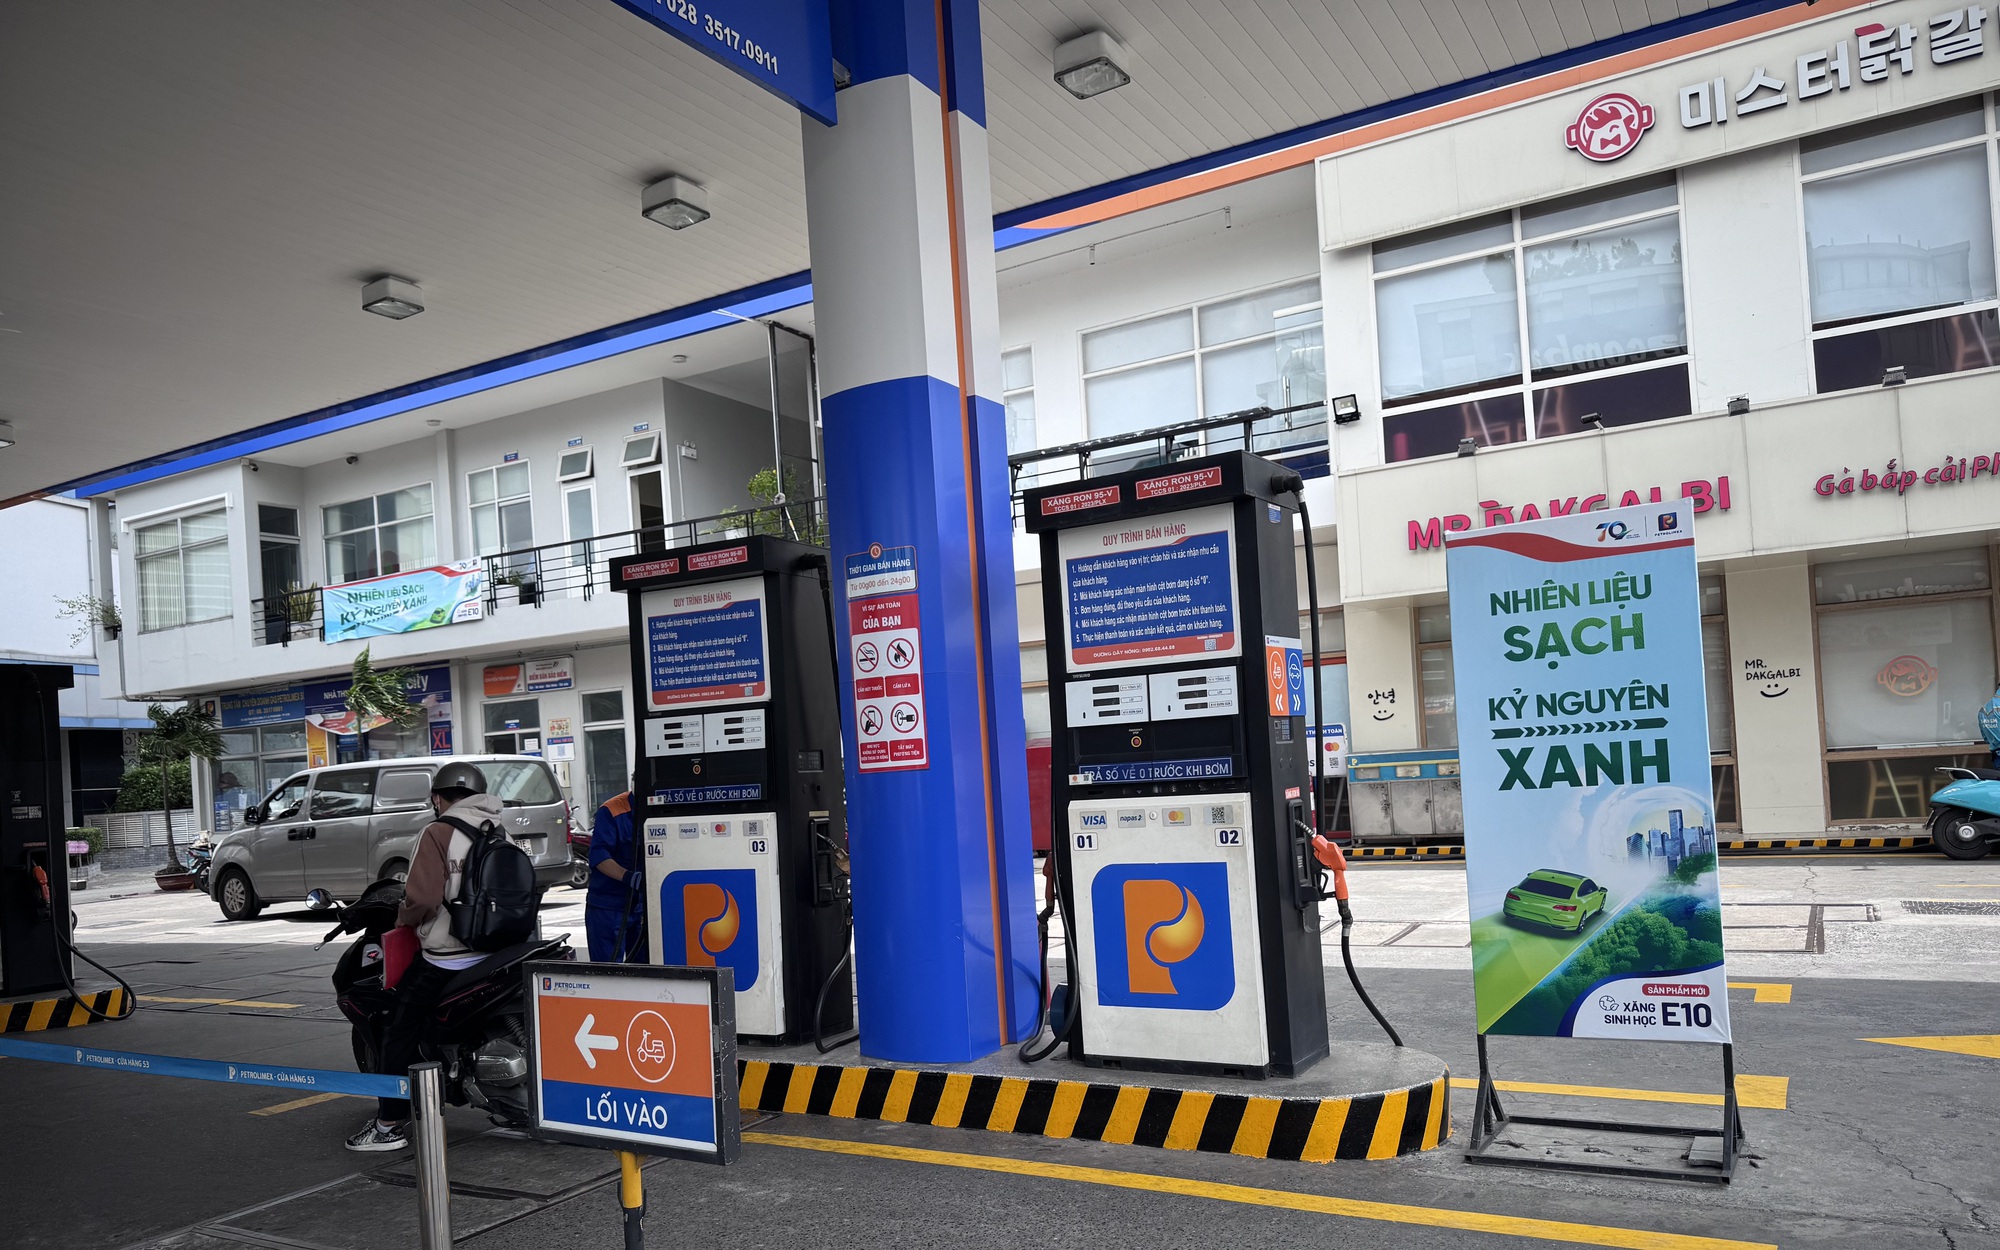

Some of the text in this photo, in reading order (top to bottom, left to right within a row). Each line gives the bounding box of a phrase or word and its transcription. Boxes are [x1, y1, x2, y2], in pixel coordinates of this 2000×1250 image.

[704, 14, 778, 74] 3517.0911
[1679, 4, 2000, 128] 미스터닭갈
[1171, 477, 1191, 486] RON
[1194, 471, 1213, 482] 95-V
[1816, 467, 1854, 496] Gà
[1861, 459, 1917, 494] bắp
[1924, 455, 1966, 484] cải
[1074, 494, 1092, 502] RON
[1094, 490, 1112, 498] 95-V
[1103, 523, 1186, 546] QUY TRÌNH BÁN HÀNG
[1103, 560, 1116, 569] khách
[1117, 559, 1128, 568] hàng
[1200, 546, 1209, 556] nhu
[849, 558, 910, 574] THỜI GIAN BÁN HÀNG
[859, 581, 875, 590] 00g00
[877, 578, 889, 588] đến
[891, 576, 910, 586] 24g00
[348, 589, 385, 603] NHIÊN
[674, 591, 732, 608] QUY TRÌNH BÁN HÀNG
[1489, 570, 1651, 616] NHIÊN LIỆU
[402, 596, 428, 612] XANH
[863, 615, 901, 629] CỦA BẠN
[1504, 612, 1645, 670] SẠCH
[1745, 658, 1767, 669] MR.
[1746, 668, 1801, 681] DAKGALBI
[1368, 688, 1395, 705] 안녕
[1488, 678, 1669, 721] KỶ NGUYÊN
[432, 732, 451, 749] XL
[1106, 766, 1119, 780] SỐ
[1122, 765, 1136, 779] VỀ
[1140, 768, 1145, 778] 0
[1186, 765, 1202, 776] KHI
[1205, 762, 1229, 774] BƠM
[1496, 738, 1670, 791] XANH
[675, 791, 684, 802] SỐ
[687, 790, 696, 801] VỀ
[704, 789, 727, 799] RƯỚC
[729, 790, 740, 798] KHI
[742, 788, 758, 797] BƠM
[1082, 815, 1106, 826] VISA
[650, 828, 666, 836] VISA
[1076, 830, 1239, 849] 01 02
[648, 841, 765, 855] 04 03
[554, 982, 590, 990] PETROLIMEX
[1648, 984, 1705, 995] SẢN PHẨM MỚI
[1604, 1015, 1656, 1027] SINH HỌC
[1623, 1001, 1712, 1028] XĂNG E10
[86, 1055, 114, 1065] PETROLIMEX
[128, 1058, 141, 1067] HÀNG
[143, 1060, 149, 1068] 53
[241, 1070, 315, 1084] PETROLIMEX CỬA HÀNG 53
[586, 1091, 668, 1129] LỐI VÀO
